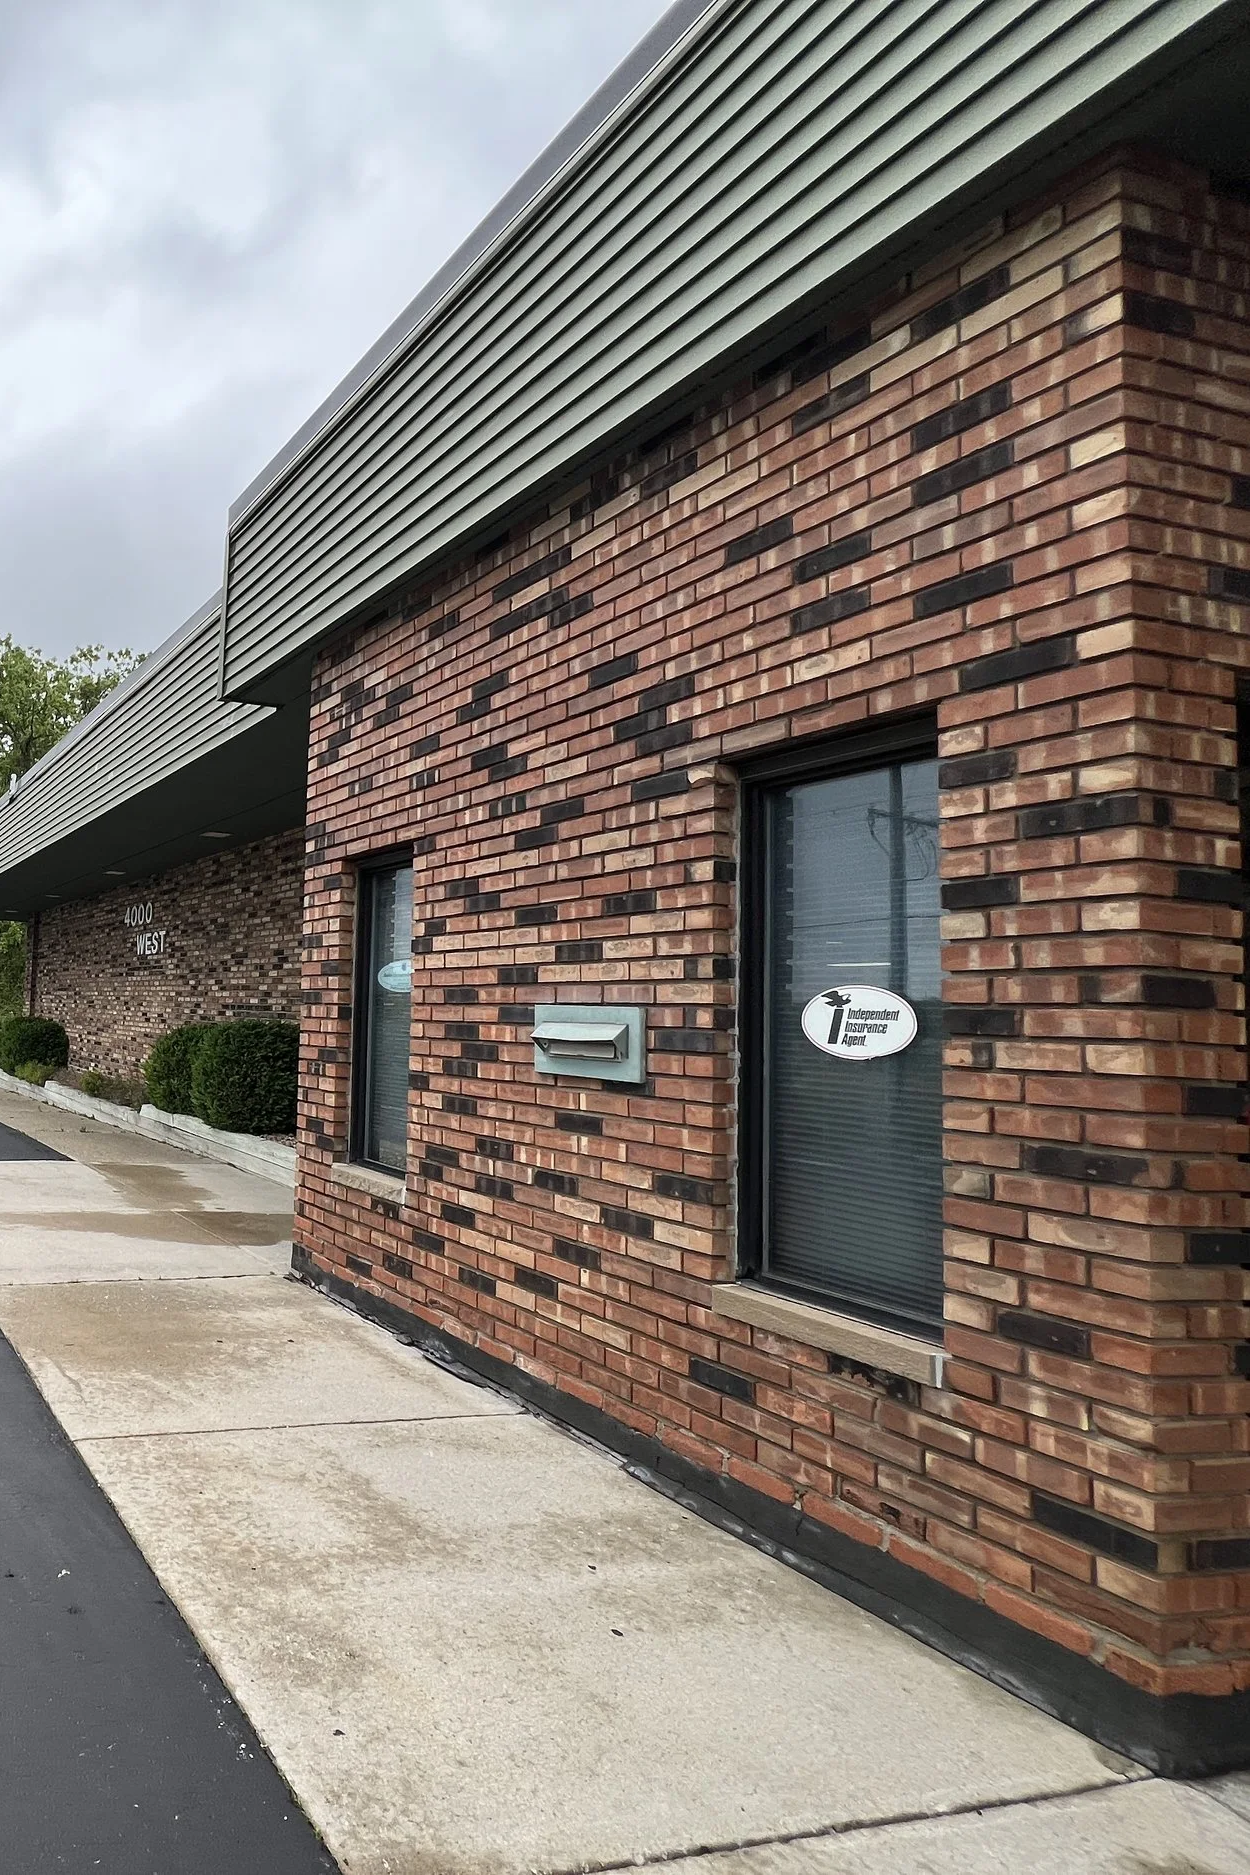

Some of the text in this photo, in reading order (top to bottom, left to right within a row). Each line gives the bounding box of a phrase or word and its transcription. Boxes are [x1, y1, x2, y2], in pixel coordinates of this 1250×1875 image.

[124, 902, 153, 927] 4000
[136, 930, 166, 955] WEST
[847, 1008, 900, 1021] Independent
[845, 1021, 888, 1034] Insurance
[841, 1034, 867, 1047] Agent
